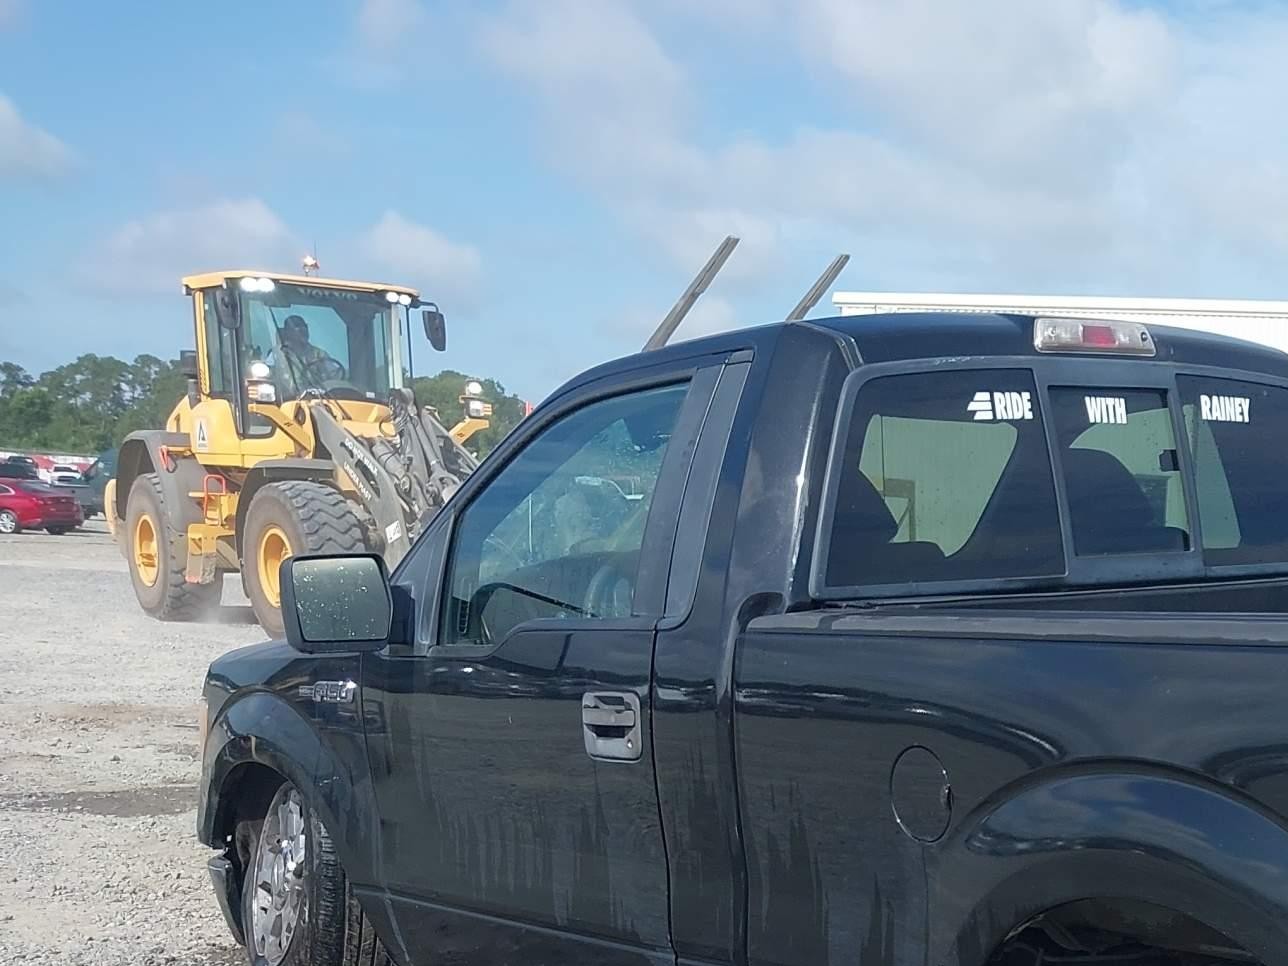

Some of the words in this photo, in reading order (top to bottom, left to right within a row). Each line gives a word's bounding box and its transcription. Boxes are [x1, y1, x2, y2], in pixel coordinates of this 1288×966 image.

[993, 391, 1033, 420] RIDE
[1084, 396, 1127, 425] WITH
[1200, 394, 1250, 423] RAINEY
